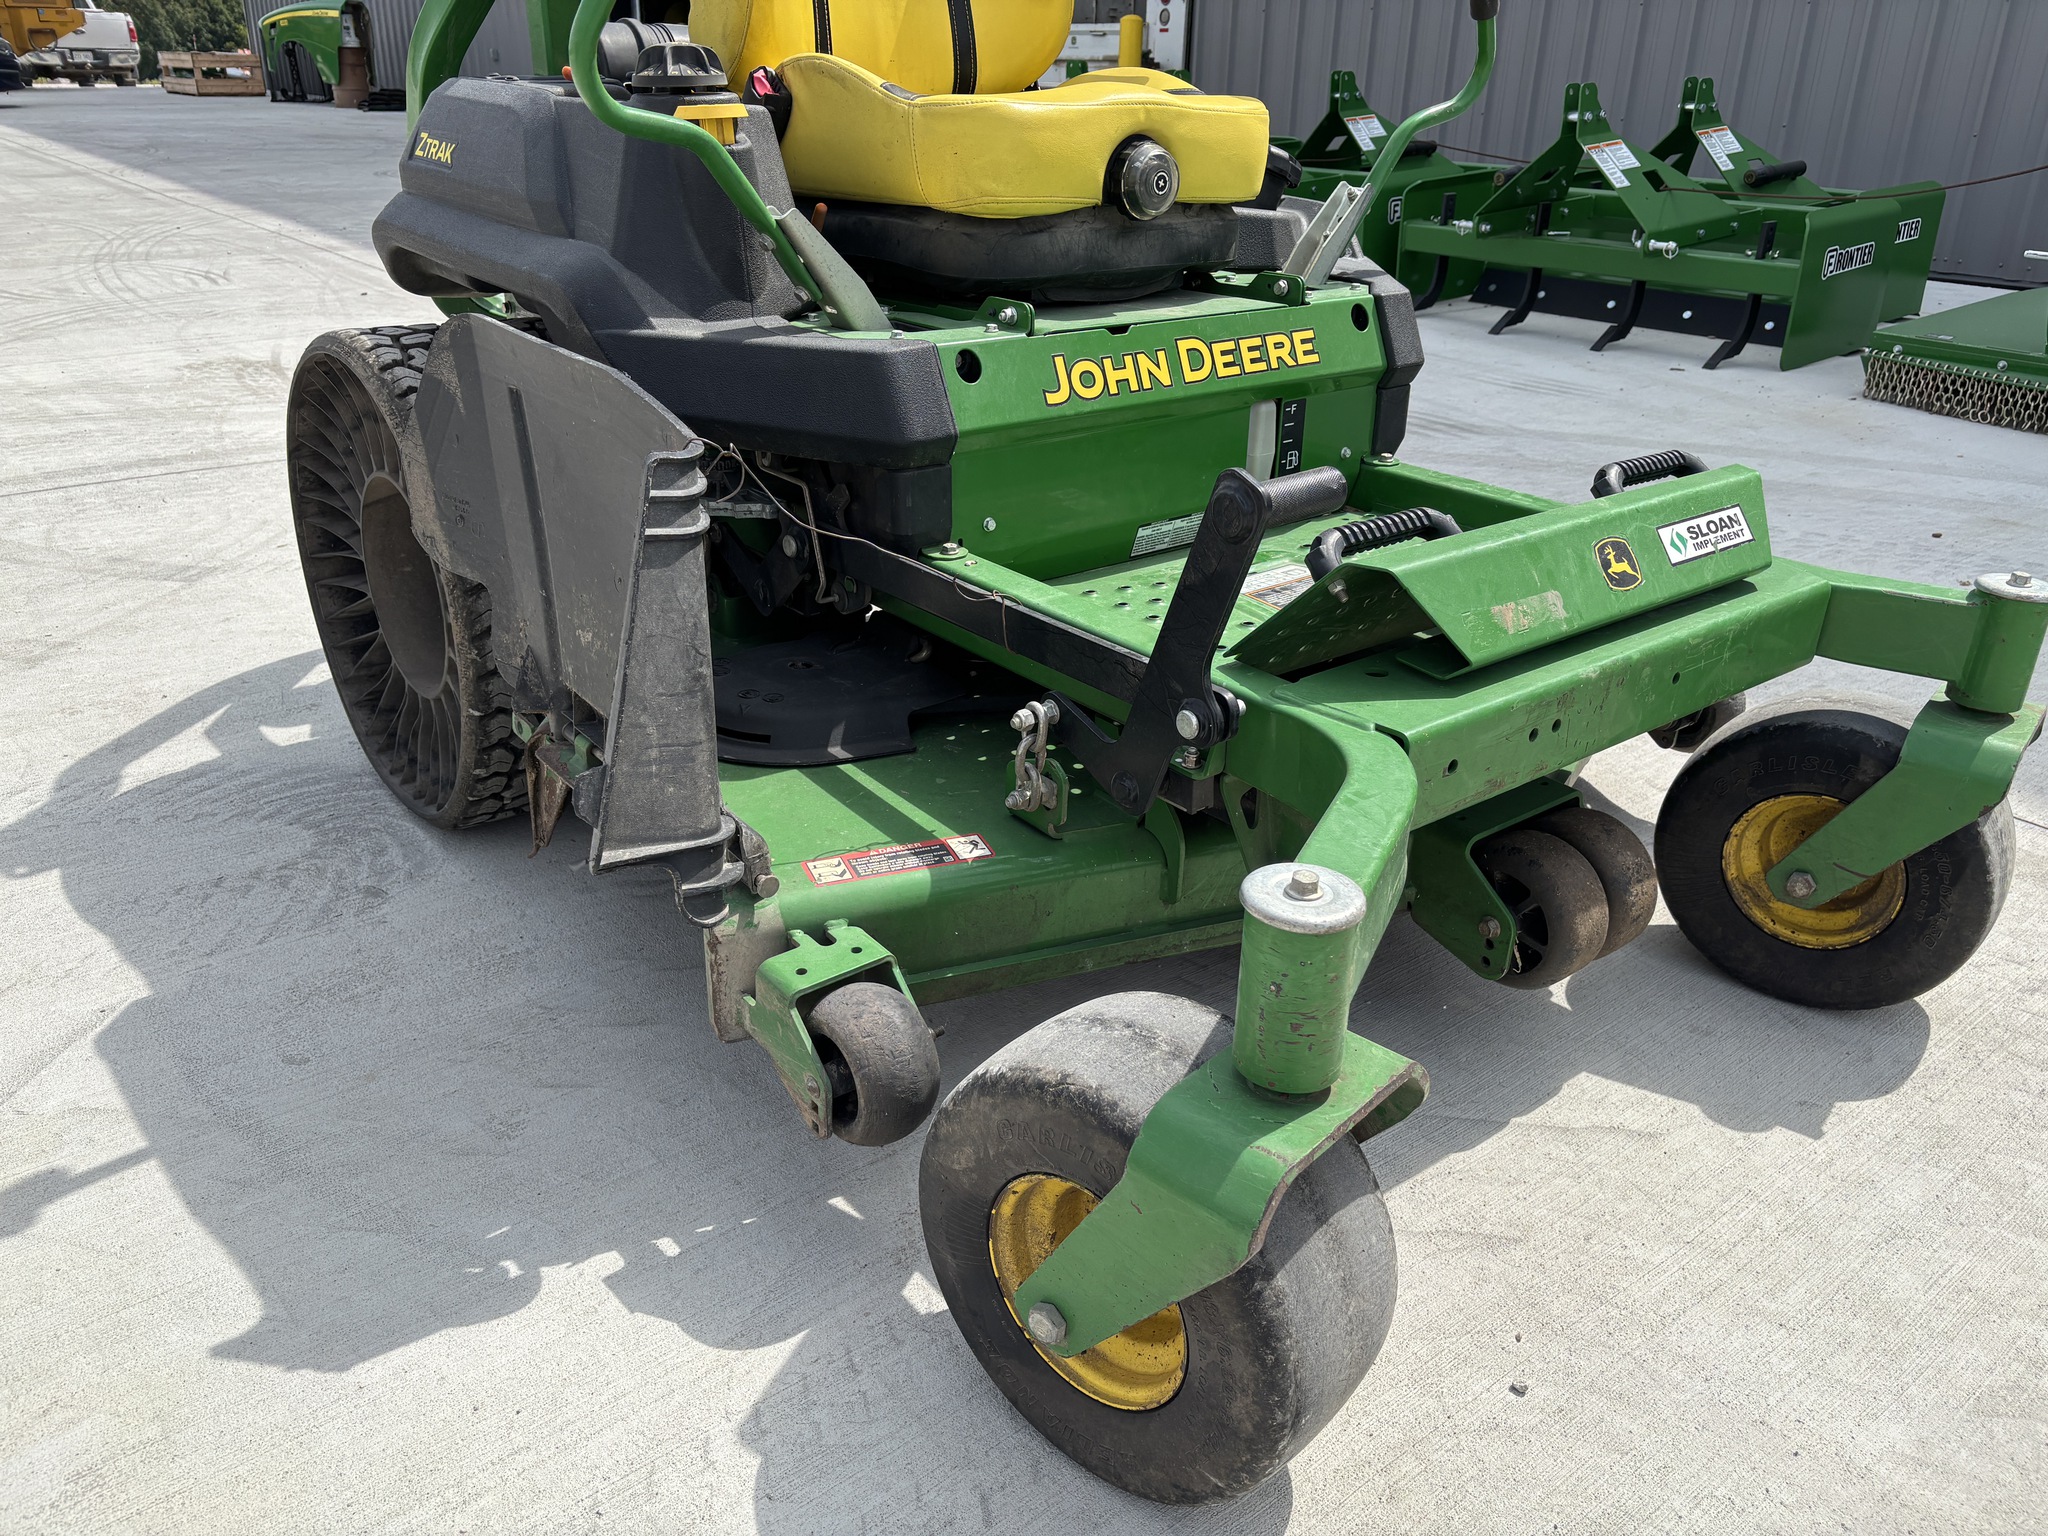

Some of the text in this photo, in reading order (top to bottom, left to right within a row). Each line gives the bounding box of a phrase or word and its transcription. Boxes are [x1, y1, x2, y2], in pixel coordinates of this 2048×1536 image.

[415, 132, 456, 164] ZTRAK
[1896, 219, 1920, 241] NTIER
[1822, 243, 1875, 279] FRONTIER
[1043, 327, 1320, 407] JOHN DEERE
[1686, 513, 1742, 541] SLOAN
[1692, 528, 1745, 552] IMPLEMENT
[1713, 755, 1861, 797] CARLISLE
[878, 843, 922, 855] DANGER
[996, 1119, 1118, 1181] CARLIS
